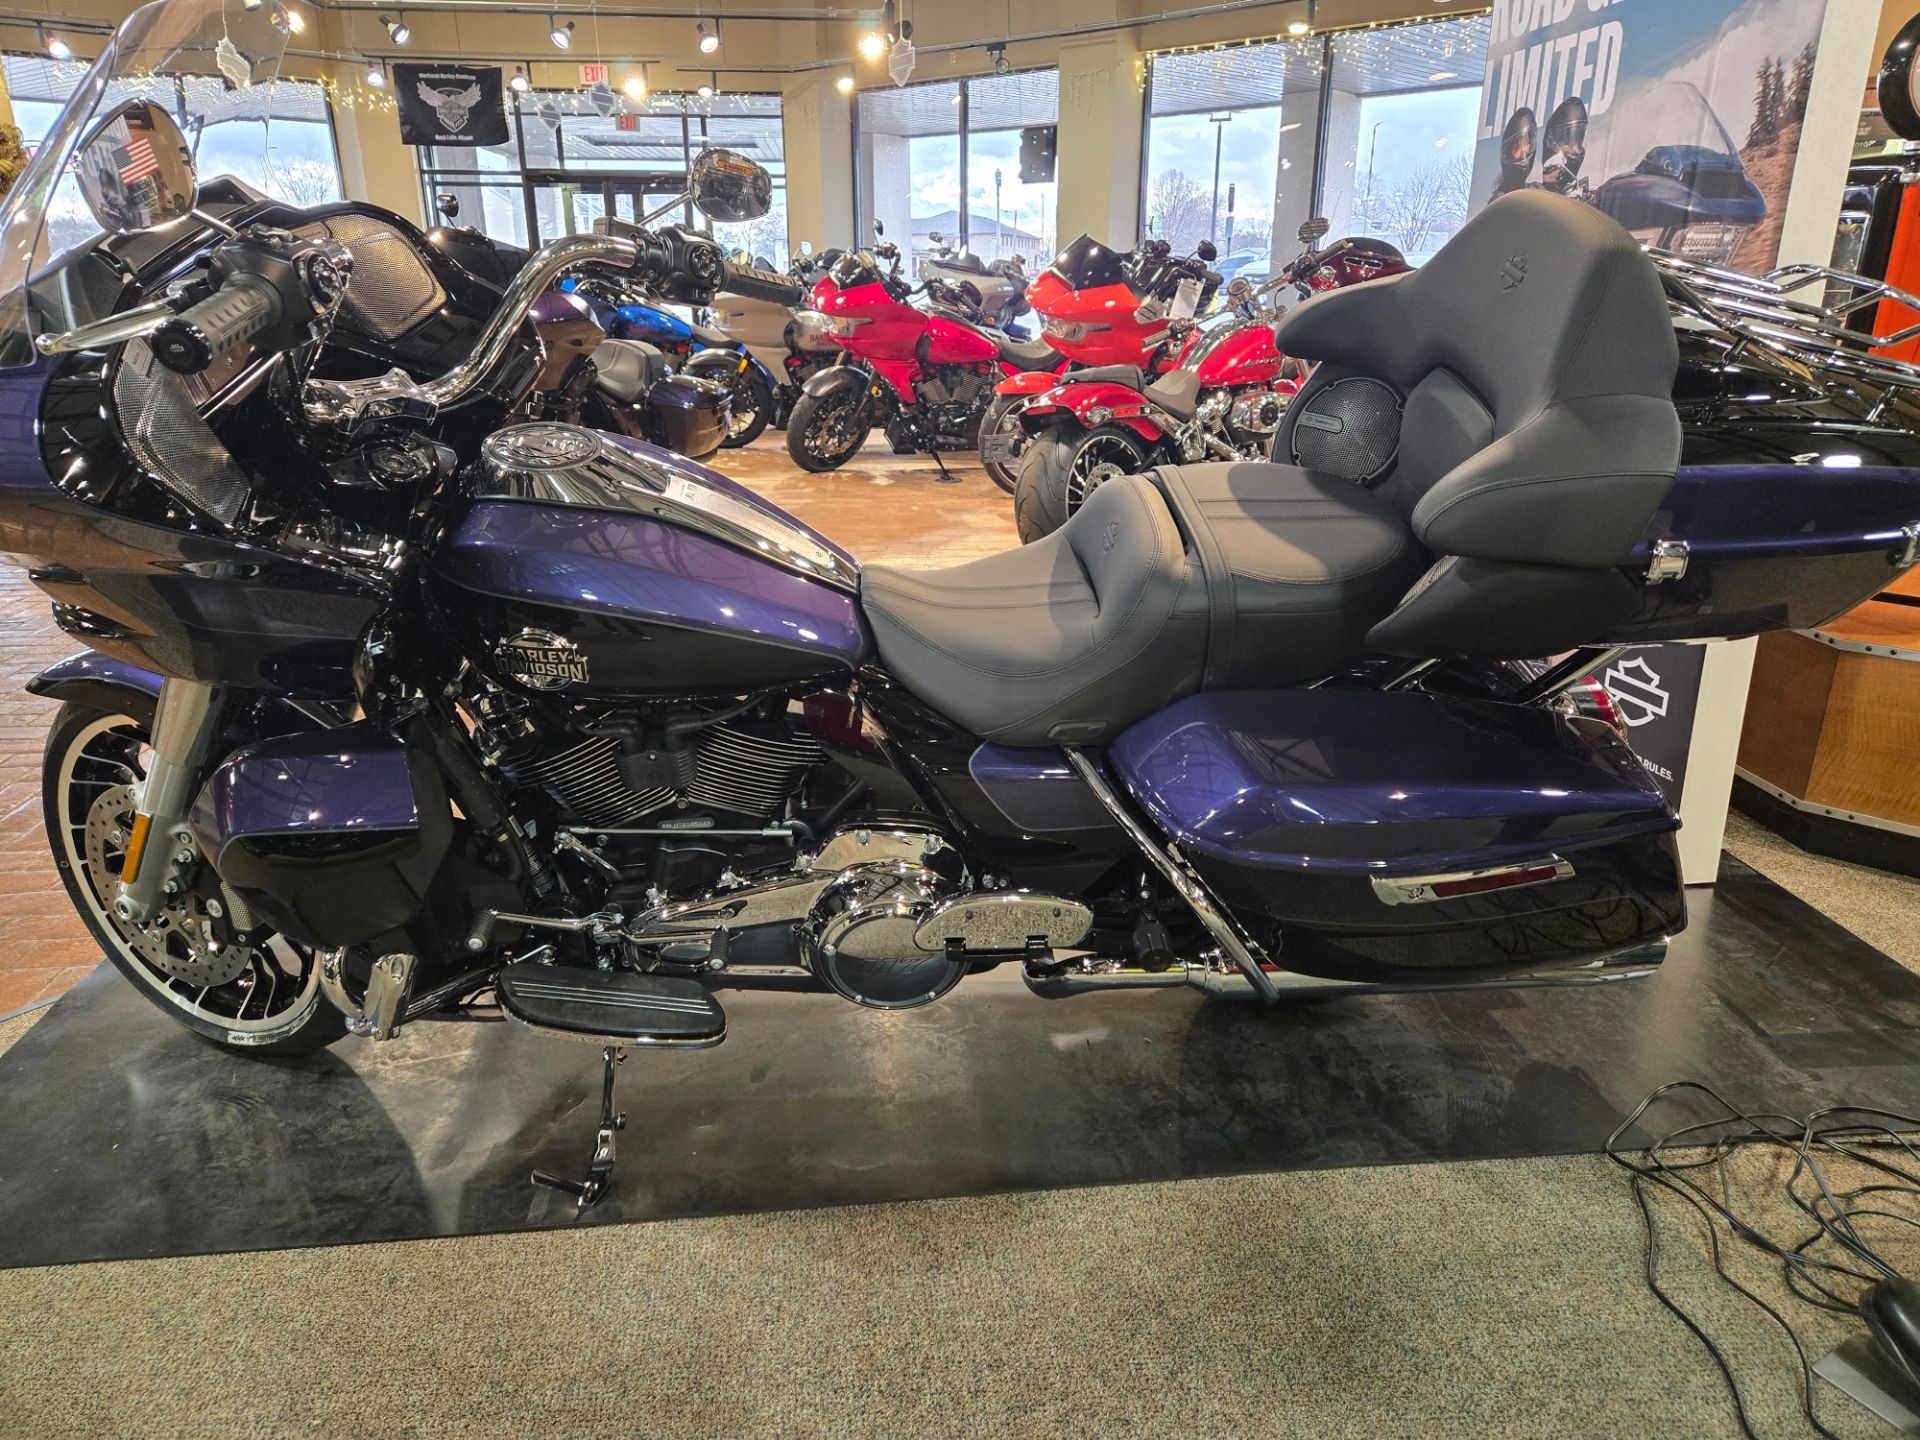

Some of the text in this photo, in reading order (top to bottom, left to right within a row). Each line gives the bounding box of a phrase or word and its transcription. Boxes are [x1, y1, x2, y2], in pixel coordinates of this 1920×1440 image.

[584, 65, 605, 83] EXIT
[1477, 20, 1624, 141] LIMITED
[620, 114, 638, 130] EXIT
[1643, 758, 1674, 782] RULES.
